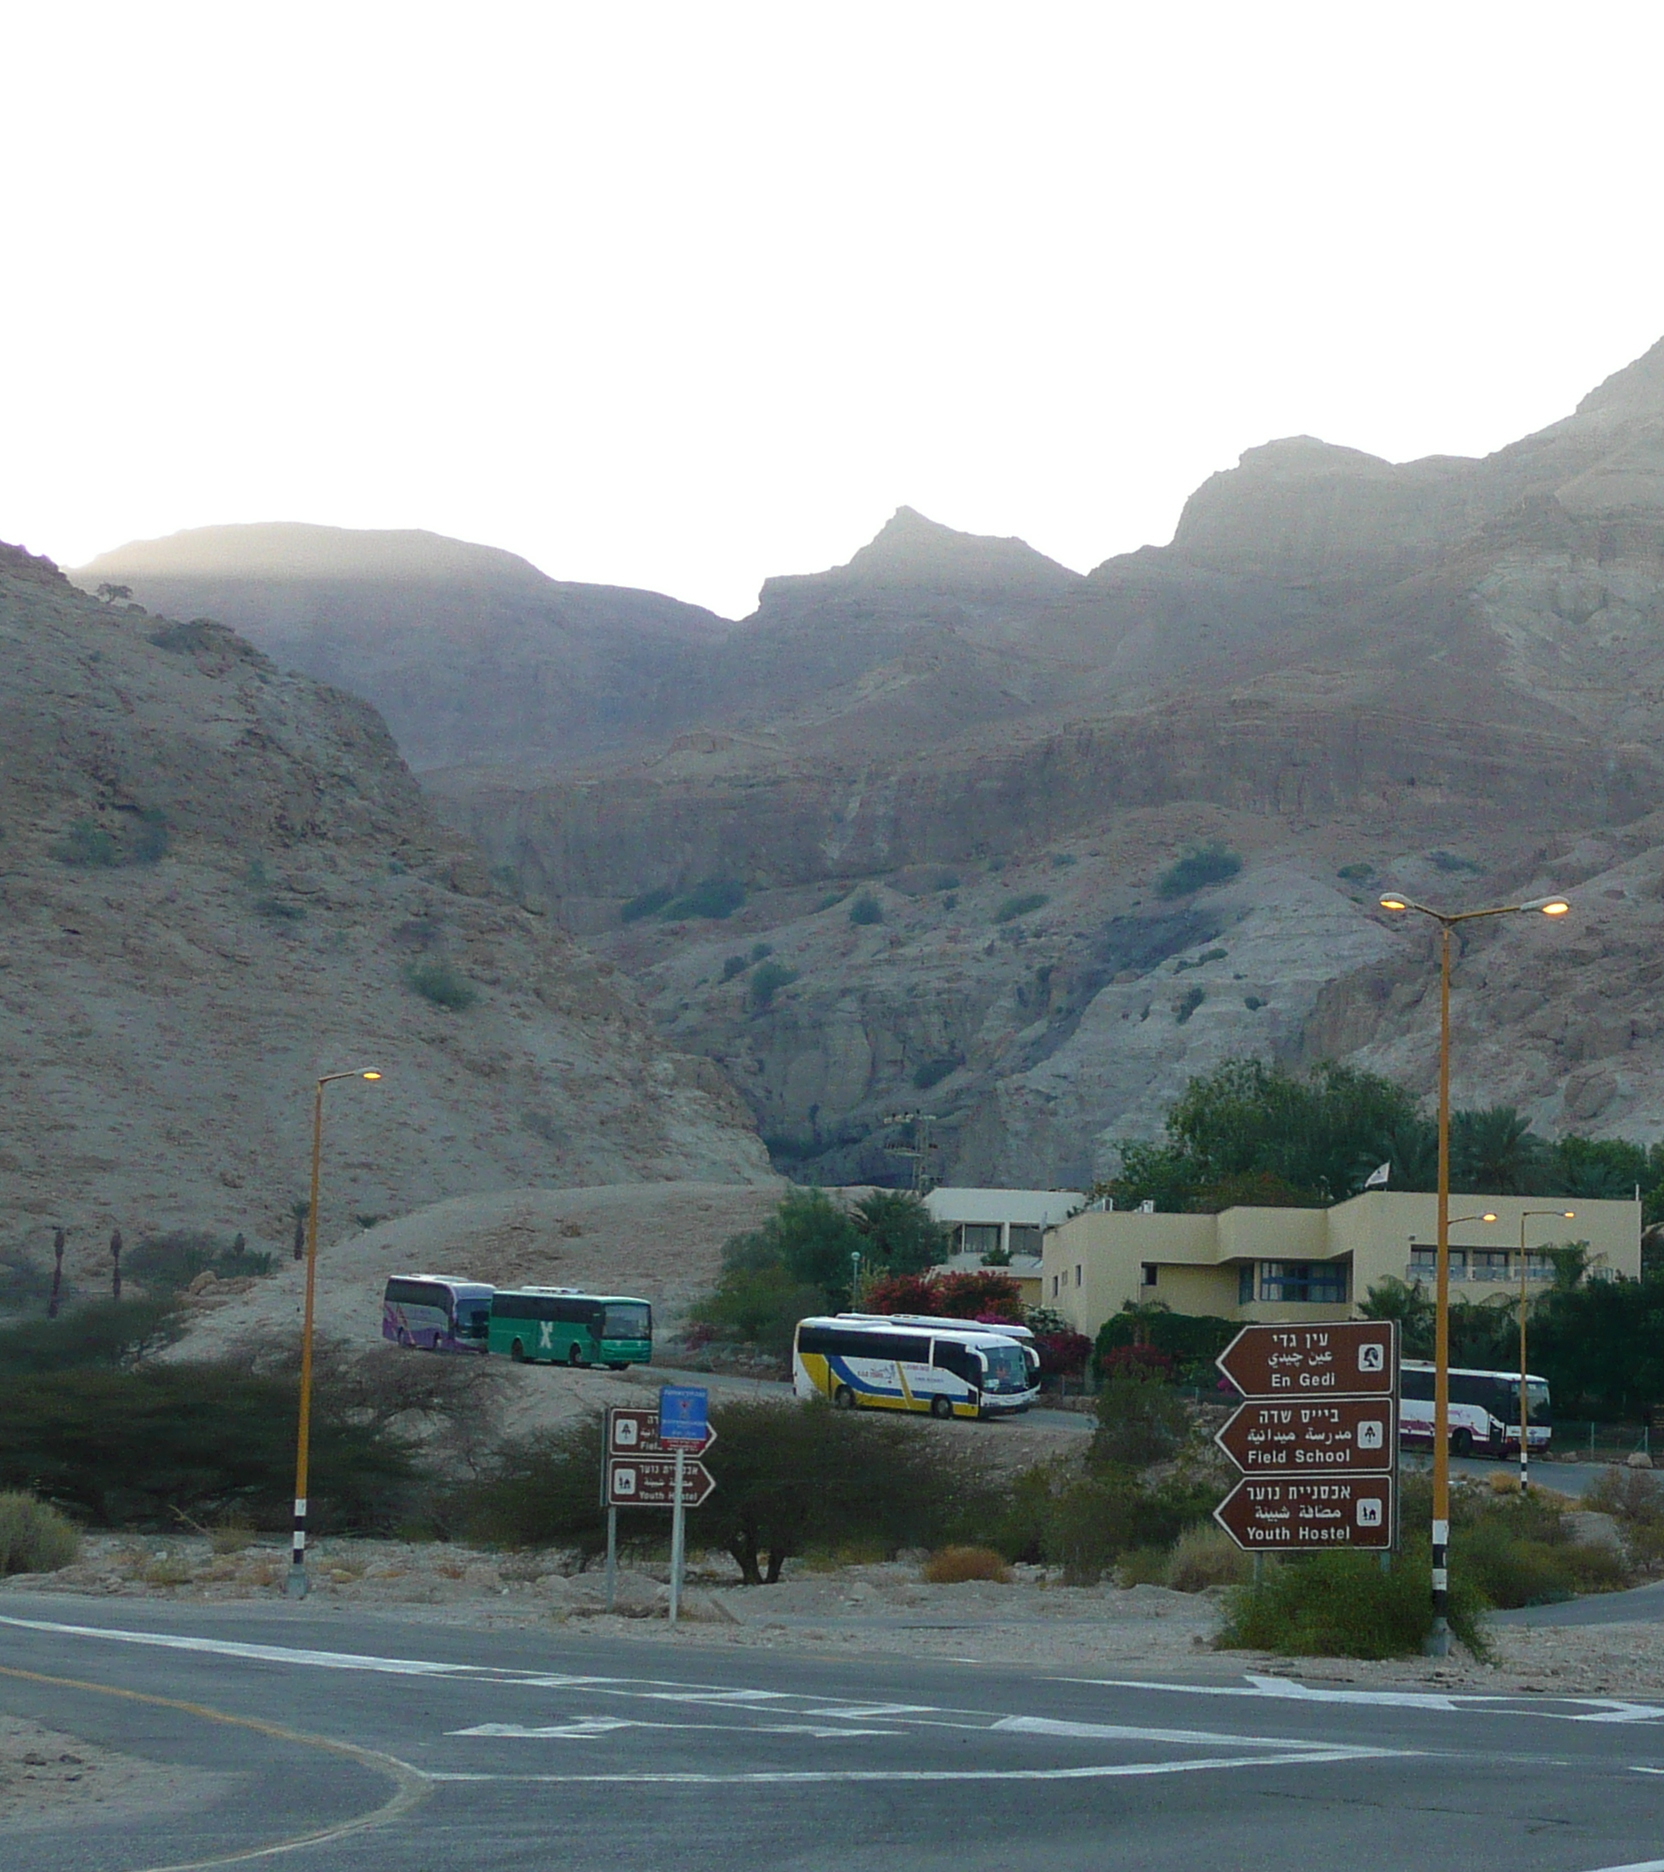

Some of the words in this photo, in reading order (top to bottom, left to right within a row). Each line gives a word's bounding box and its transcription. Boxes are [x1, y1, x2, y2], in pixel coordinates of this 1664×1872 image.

[1272, 1333, 1297, 1348] גדי
[1305, 1332, 1329, 1349] עין
[1308, 1350, 1333, 1367] عين
[1271, 1373, 1291, 1387] En
[1299, 1372, 1335, 1387] Gedi
[1259, 1410, 1292, 1424] שדה
[1247, 1428, 1296, 1445] ميدانية
[1305, 1427, 1352, 1445] مدرسة
[1248, 1450, 1286, 1464] Field
[1295, 1448, 1350, 1463] School
[638, 1490, 665, 1500] Youth
[668, 1491, 698, 1502] Hstel
[1246, 1486, 1280, 1501] נוער
[1288, 1485, 1351, 1501] אכסניית
[1246, 1526, 1291, 1541] Youth
[1299, 1525, 1350, 1541] Hostel
